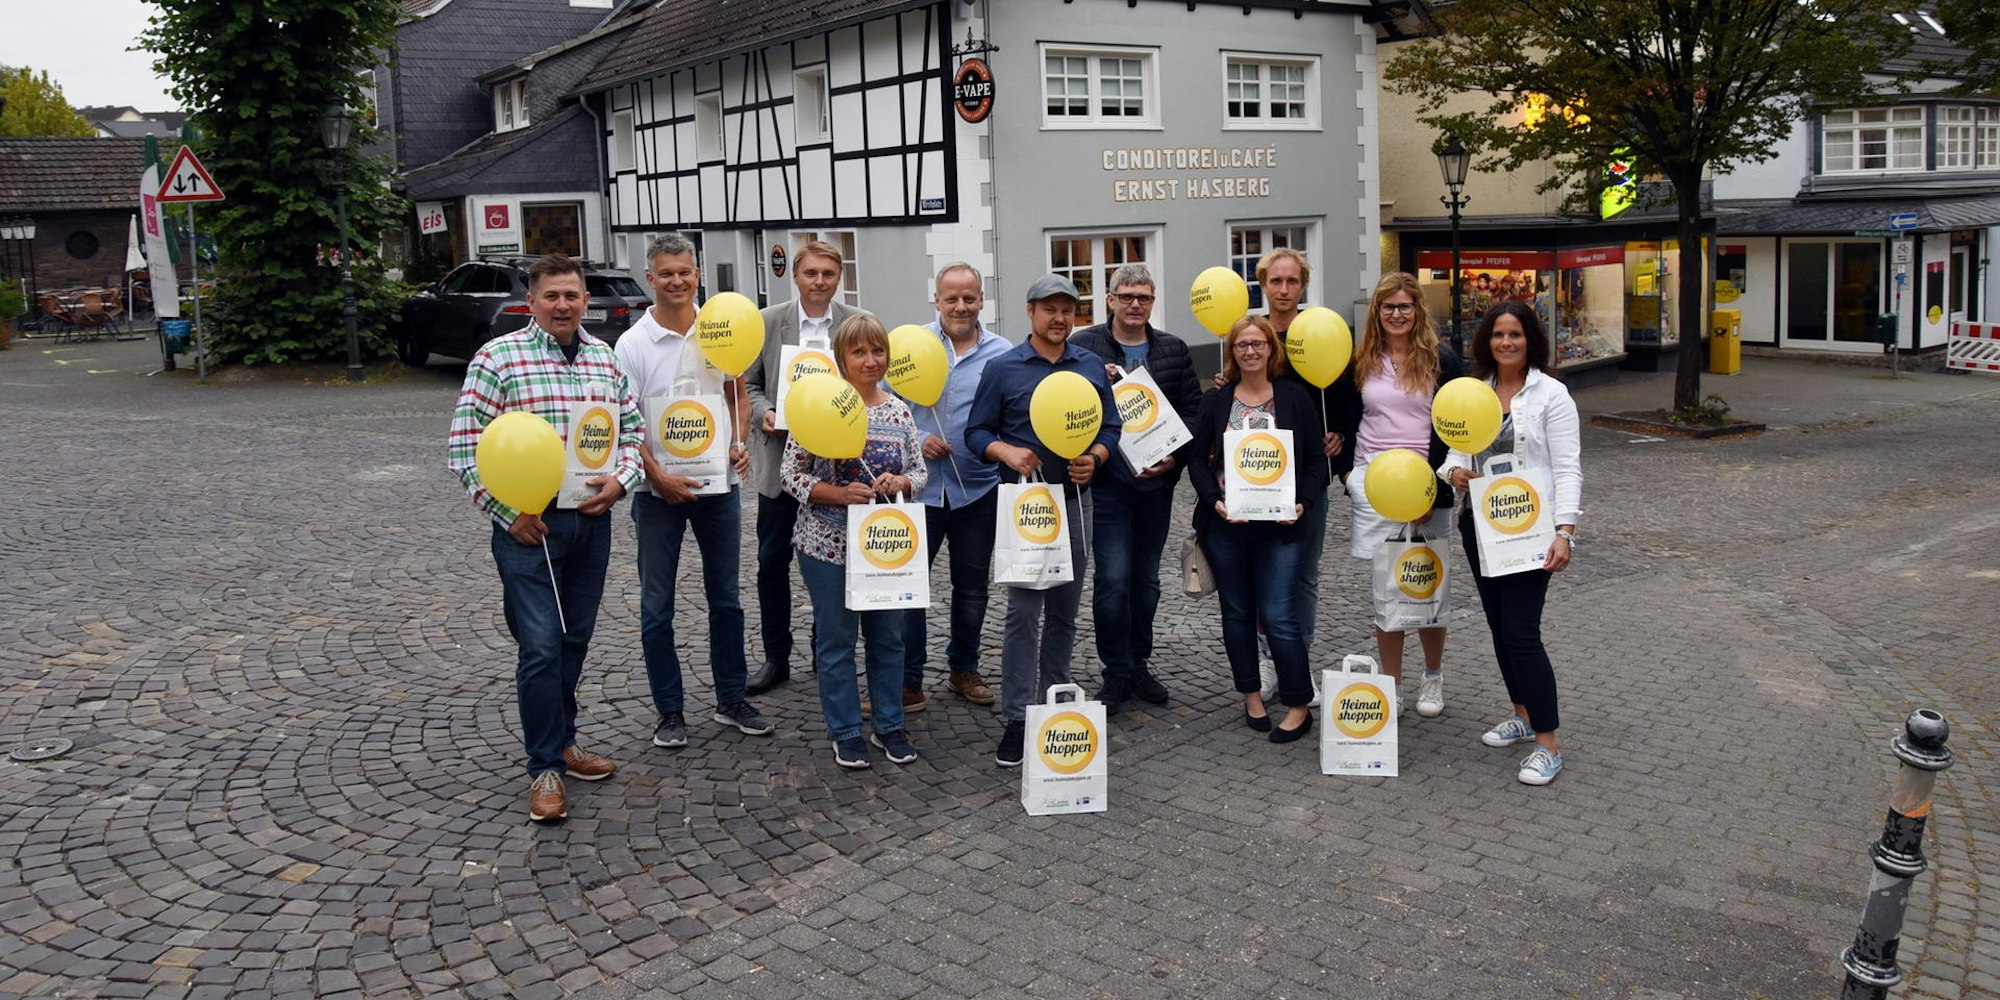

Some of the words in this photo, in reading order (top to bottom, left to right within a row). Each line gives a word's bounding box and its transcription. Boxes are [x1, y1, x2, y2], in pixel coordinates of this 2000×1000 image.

[955, 83, 991, 98] E-VAPE
[1102, 148, 1218, 170] CONDITOREI
[1231, 144, 1277, 168] CAFÉ
[1114, 179, 1179, 202] ERNST
[1186, 177, 1270, 200] HASBERG
[1064, 404, 1097, 422] Heimat
[666, 416, 707, 429] Heimat
[583, 424, 611, 437] Heimat
[664, 429, 709, 442] shoppen
[578, 437, 610, 452] shoppen
[1240, 448, 1280, 458] Heimat
[1239, 459, 1281, 470] shoppen
[1488, 491, 1530, 508] Heimat
[1490, 503, 1535, 519] shoppen
[866, 526, 910, 538] Heimat
[864, 538, 913, 553] shoppen
[1340, 698, 1381, 710] Heimat
[1338, 711, 1383, 723] shoppen
[1045, 729, 1089, 742] Heimat
[1043, 743, 1092, 757] shoppen
